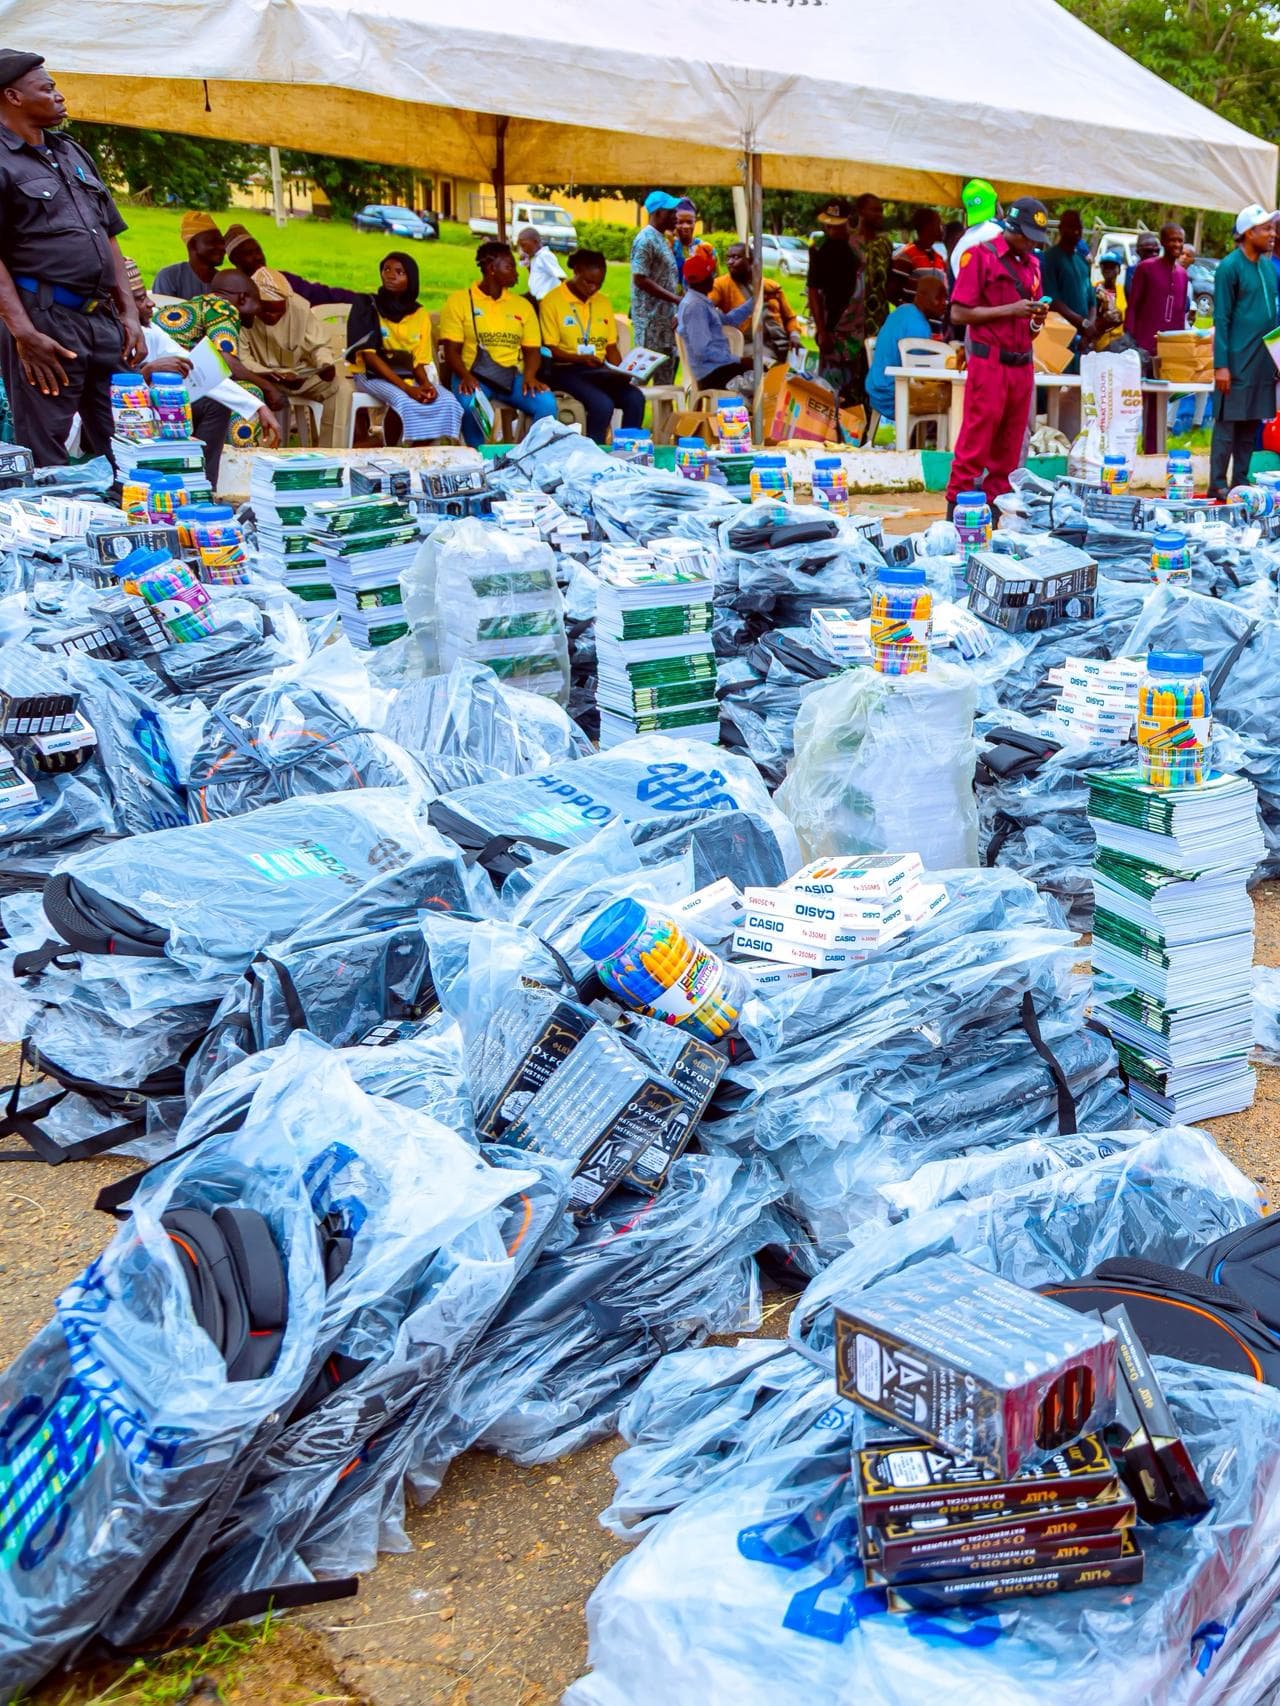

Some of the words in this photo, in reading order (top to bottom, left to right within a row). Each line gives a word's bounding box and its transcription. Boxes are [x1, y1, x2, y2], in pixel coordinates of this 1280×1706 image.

[1070, 677, 1088, 688] CASIO
[1057, 704, 1074, 714] CASIO
[1086, 696, 1105, 707] CASIO
[48, 741, 71, 749] CASIO
[527, 774, 630, 826] HPPO
[888, 872, 905, 887] CASIO
[795, 904, 836, 921] CASIO
[862, 911, 881, 919] CASIO
[882, 909, 901, 925] CASIO
[749, 917, 784, 933] CASIO
[737, 937, 773, 952] CASIO
[825, 954, 846, 962] CASIO
[531, 1045, 564, 1068] OXFO
[525, 1060, 554, 1077] MATHEM
[674, 1059, 716, 1091] OXFORD
[627, 1100, 667, 1131] OXFORD
[618, 1113, 656, 1141] MATHEMATICAL
[1118, 1343, 1139, 1381] OXFORD
[964, 1375, 974, 1462] OXFORD
[945, 1492, 1005, 1506] MATHEMATICAL
[1024, 1490, 1048, 1503] LILY
[888, 1499, 944, 1512] INSTRUMENTS
[937, 1499, 1004, 1514] OXFORD
[966, 1526, 1026, 1541] MATHEMATICAL
[1044, 1522, 1066, 1534] LILY
[910, 1537, 965, 1553] INSTRUMENTS
[958, 1534, 1025, 1551] OXFORD
[976, 1547, 1036, 1562] MATHEMATICAL
[1055, 1545, 1079, 1557] LILY
[969, 1554, 1035, 1569] OXFORD
[1000, 1571, 1059, 1586] MATHEMATICAL
[1078, 1569, 1101, 1580] LILY
[943, 1578, 998, 1592] INSTRUMENTS
[991, 1578, 1058, 1594] OXFORD
